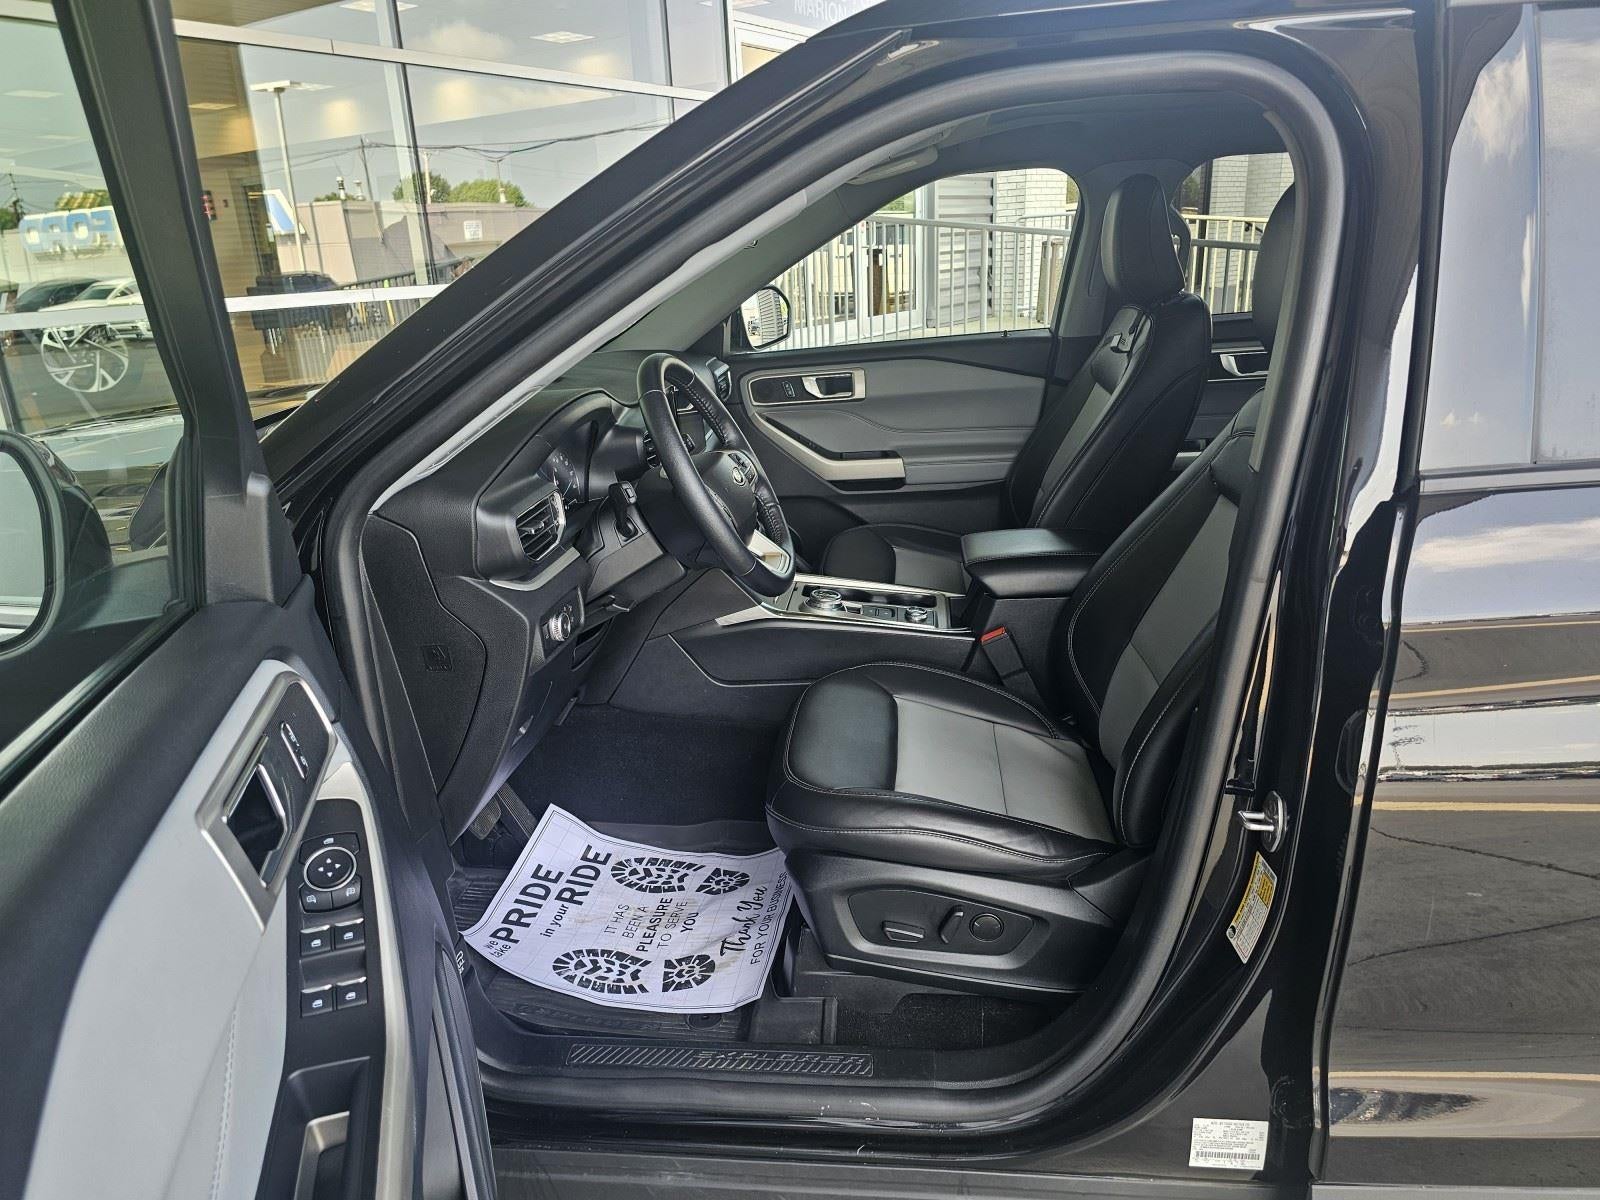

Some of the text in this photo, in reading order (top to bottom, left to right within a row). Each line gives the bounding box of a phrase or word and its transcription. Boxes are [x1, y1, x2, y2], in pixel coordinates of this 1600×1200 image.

[554, 844, 613, 906] RIDE
[489, 863, 565, 944] PRIDE
[737, 886, 767, 912] You
[540, 904, 569, 938] in your
[604, 904, 630, 934] IT HAS
[622, 905, 648, 938] BEEN A
[636, 897, 673, 952] PLEASURE
[657, 901, 688, 949] TO SERVE
[680, 912, 699, 933] YOU
[756, 913, 774, 939] YOUR
[750, 941, 766, 965] FOR
